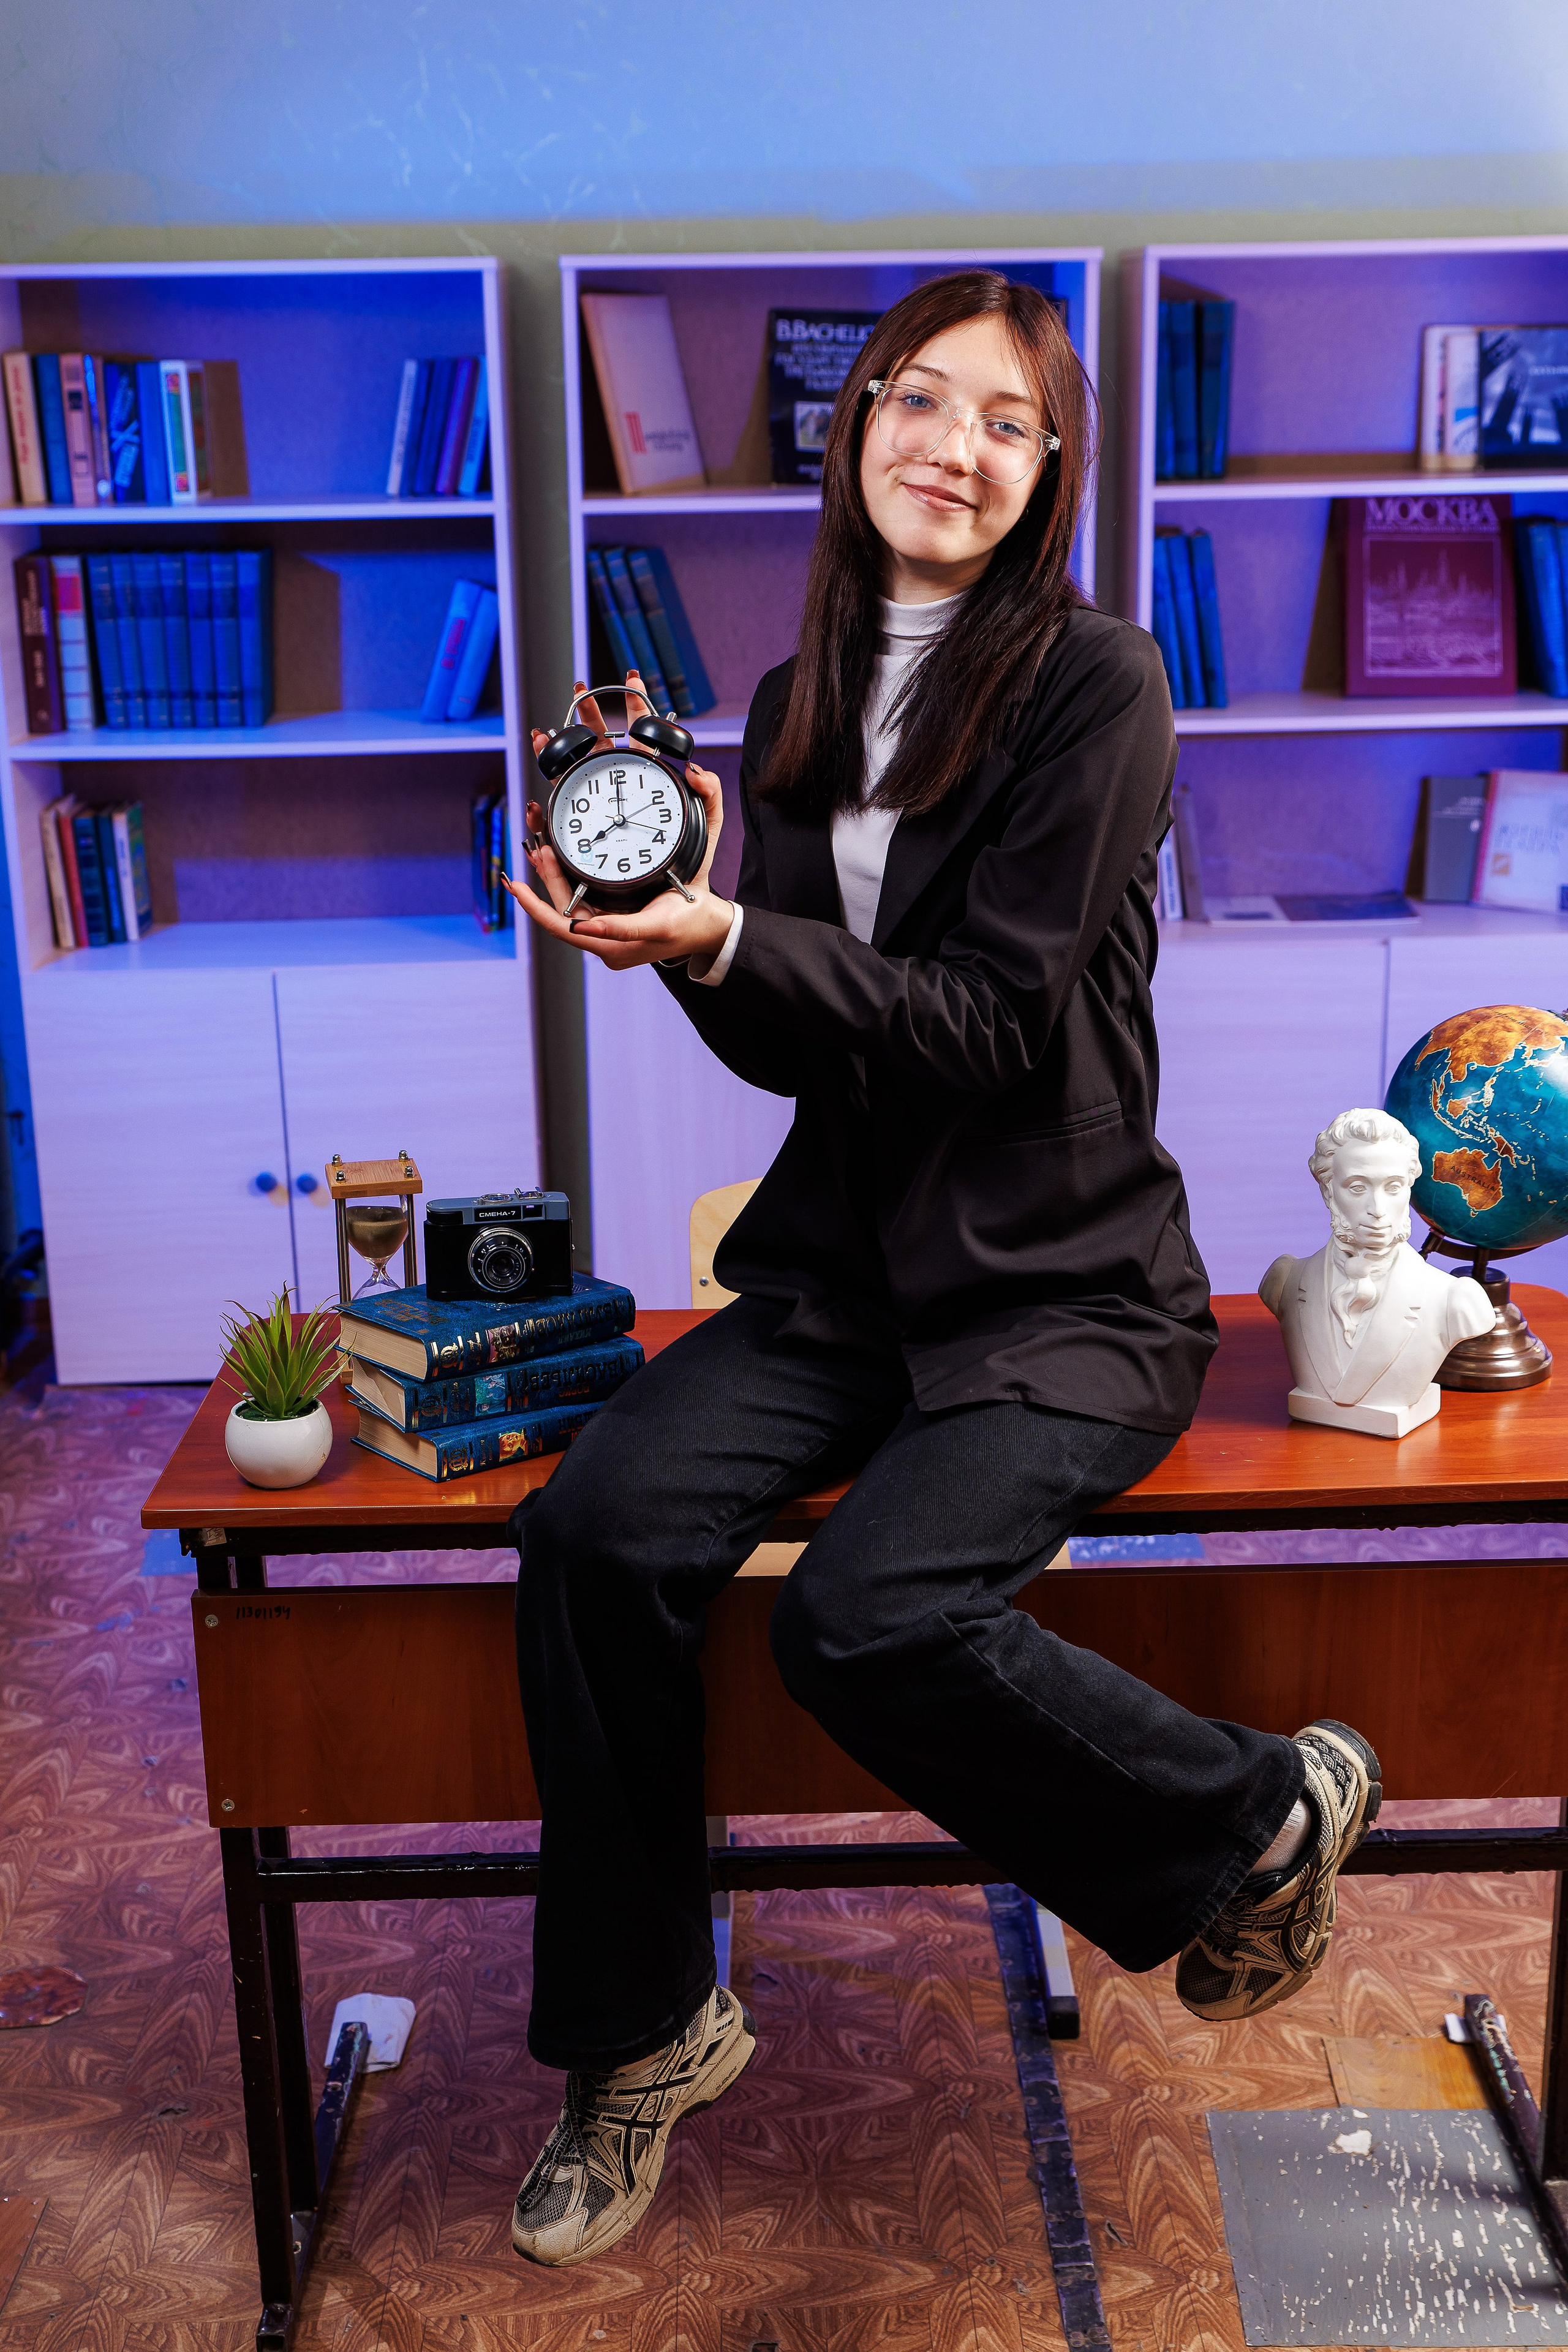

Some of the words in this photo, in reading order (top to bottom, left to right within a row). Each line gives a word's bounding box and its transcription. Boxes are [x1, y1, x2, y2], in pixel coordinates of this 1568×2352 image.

[1366, 497, 1498, 524] МОСКВА
[609, 770, 627, 785] 12
[639, 774, 644, 789] 1
[588, 780, 600, 794] 11
[651, 790, 665, 805] 2
[571, 798, 590, 813] 10
[659, 809, 672, 824] 3
[569, 818, 582, 834] 9
[652, 830, 666, 845] 4
[578, 839, 592, 853] 8
[595, 854, 608, 869] 7
[639, 849, 652, 864] 5
[617, 858, 631, 873] 6
[1450, 1165, 1495, 1191] AUSTRALIA
[535, 1302, 613, 1336] БУЛГАКОВ
[530, 1363, 617, 1392] ВАСИЛЬЕВ
